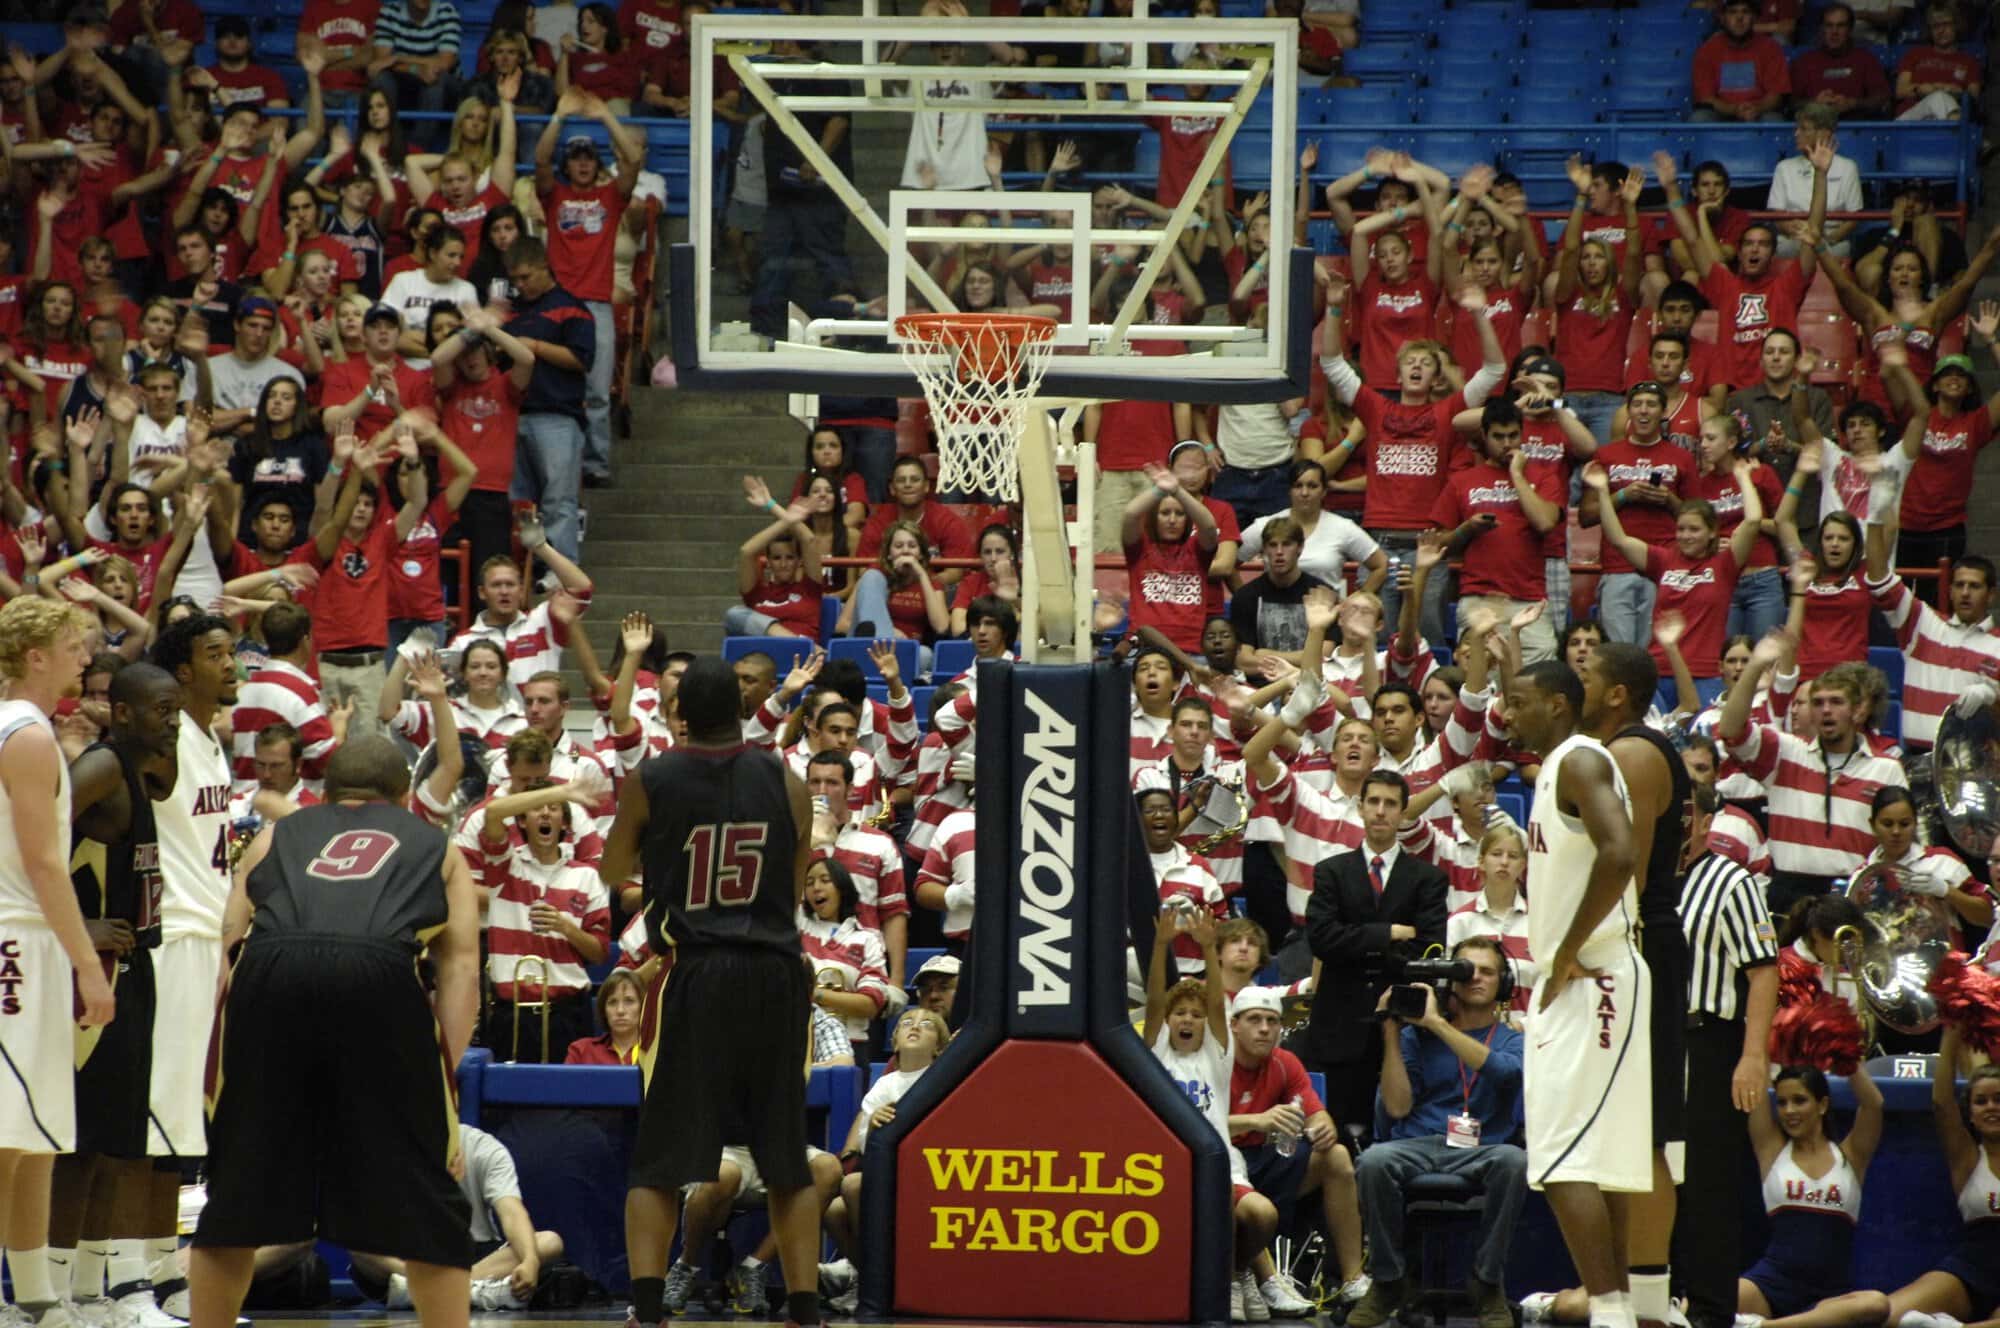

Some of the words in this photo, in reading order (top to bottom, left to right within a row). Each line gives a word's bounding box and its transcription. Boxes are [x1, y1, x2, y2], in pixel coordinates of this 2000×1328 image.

[306, 829, 400, 881] 9
[682, 821, 767, 912] 15
[1018, 688, 1076, 1006] ARIZONA
[0, 940, 24, 1015] CATS
[1593, 975, 1614, 1049] CATS
[923, 1148, 1165, 1197] WELLS
[930, 1206, 1160, 1256] FARGO
